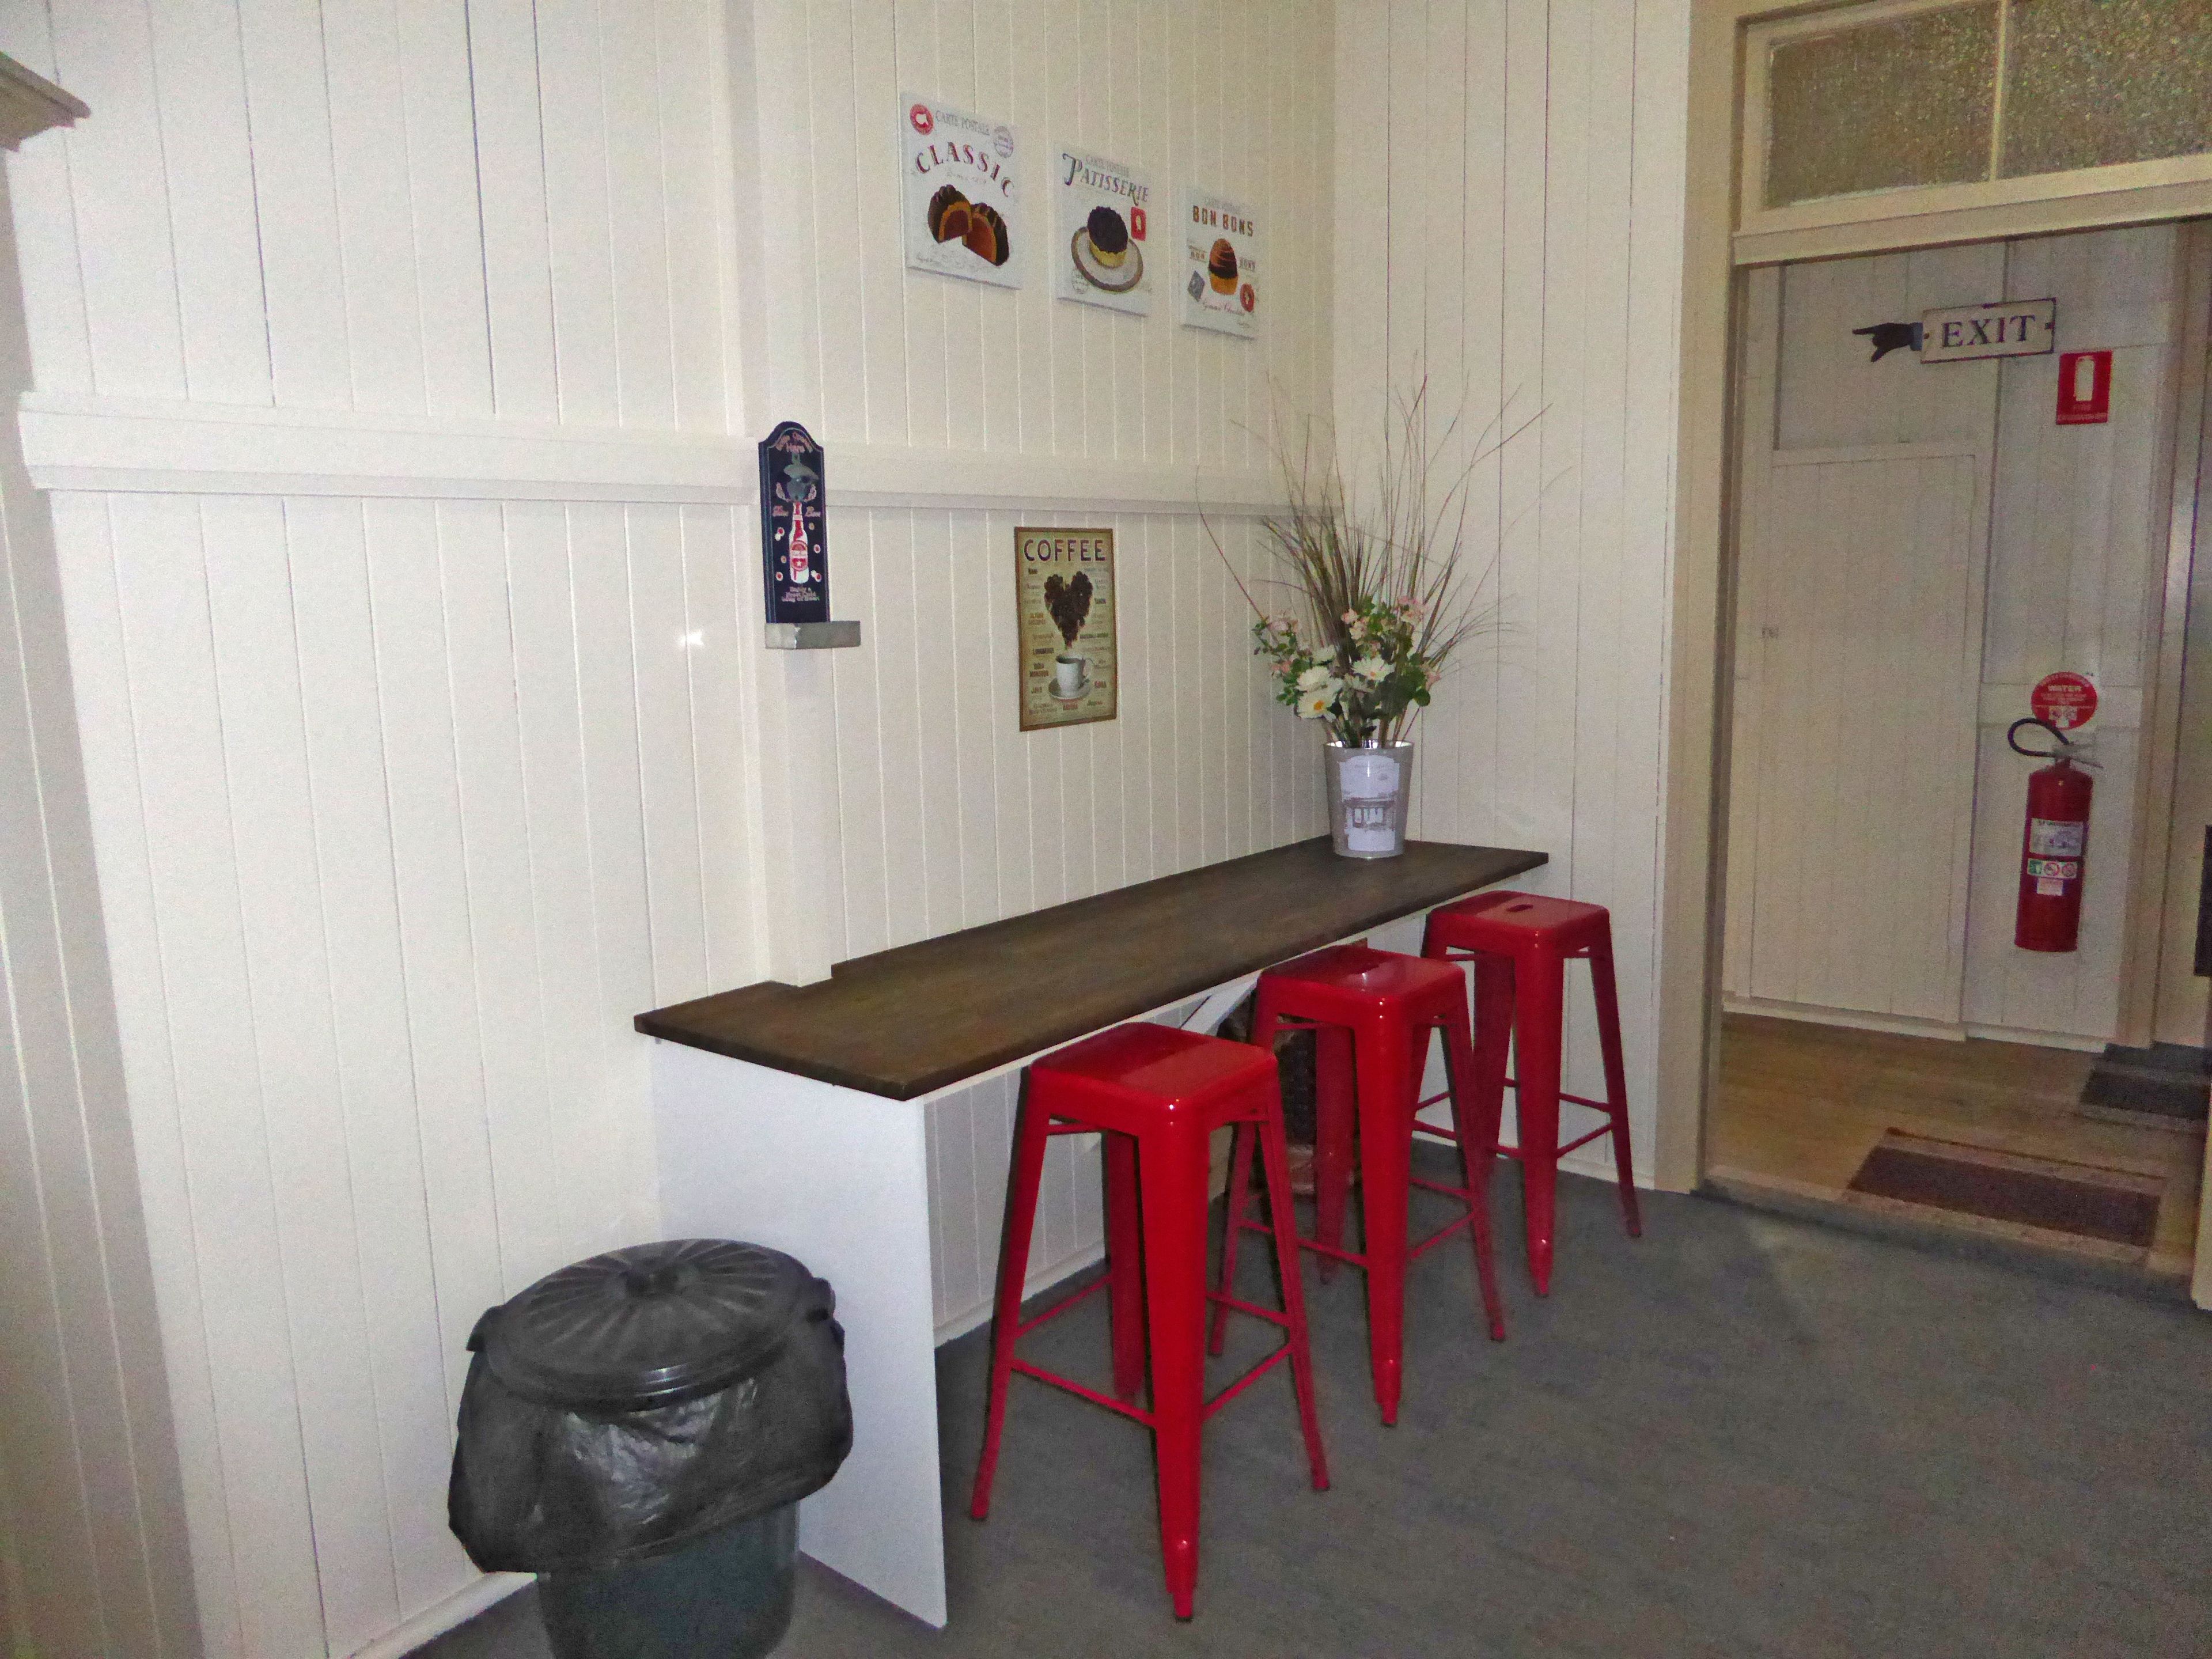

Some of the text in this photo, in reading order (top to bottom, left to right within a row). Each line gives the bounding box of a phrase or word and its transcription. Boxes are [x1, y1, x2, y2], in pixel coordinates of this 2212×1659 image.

[935, 110, 958, 127] CARTE
[916, 141, 1015, 198] CLASSIC
[1062, 153, 1149, 206] PATISSERIE
[1192, 205, 1254, 237] BON BONS
[1941, 314, 2036, 348] EXIT
[1024, 539, 1106, 562] COFFEE
